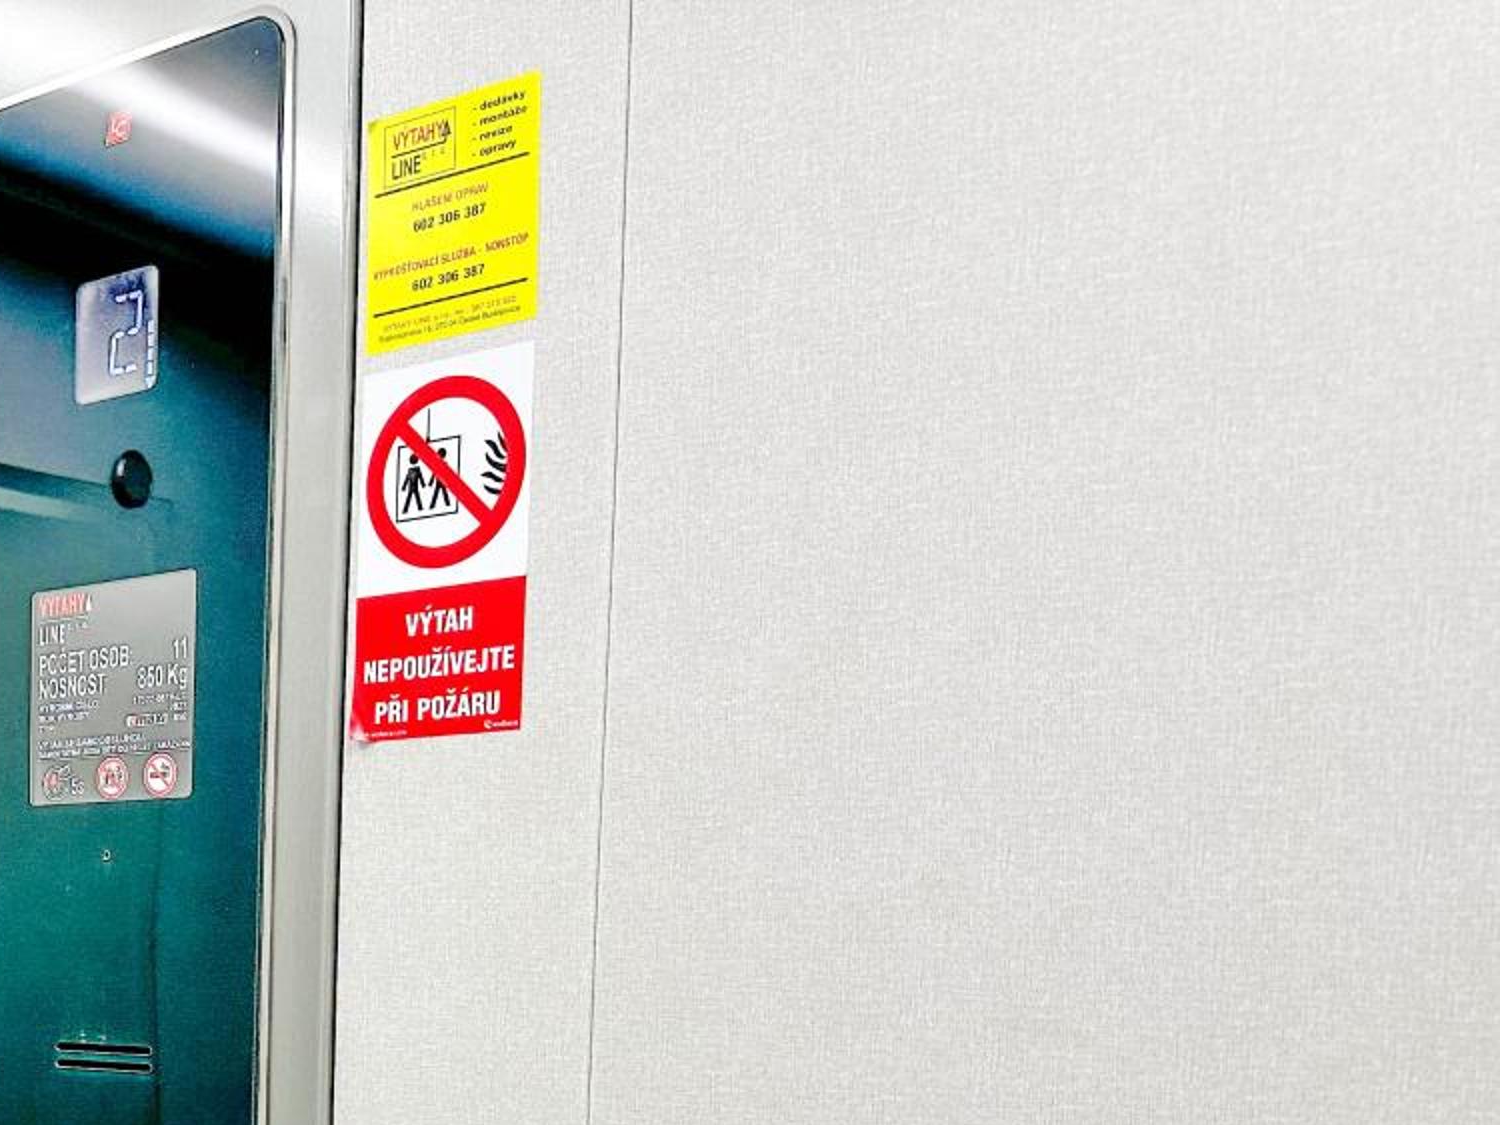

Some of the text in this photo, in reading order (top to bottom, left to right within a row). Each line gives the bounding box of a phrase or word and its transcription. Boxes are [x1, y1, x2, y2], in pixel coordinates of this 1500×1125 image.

[392, 155, 421, 180] LINE
[413, 202, 486, 232] 602 306 387
[412, 263, 485, 291] 602 306 387
[109, 289, 143, 375] 2
[38, 623, 66, 647] LINE
[405, 604, 474, 637] VÝTAH
[173, 636, 188, 660] 11
[363, 645, 515, 684] NEPOUŽÍVEJTE
[38, 673, 106, 700] NOSNOST
[137, 665, 163, 689] 850
[167, 663, 188, 690] Kg
[374, 687, 501, 725] PŘI POŽÁRU
